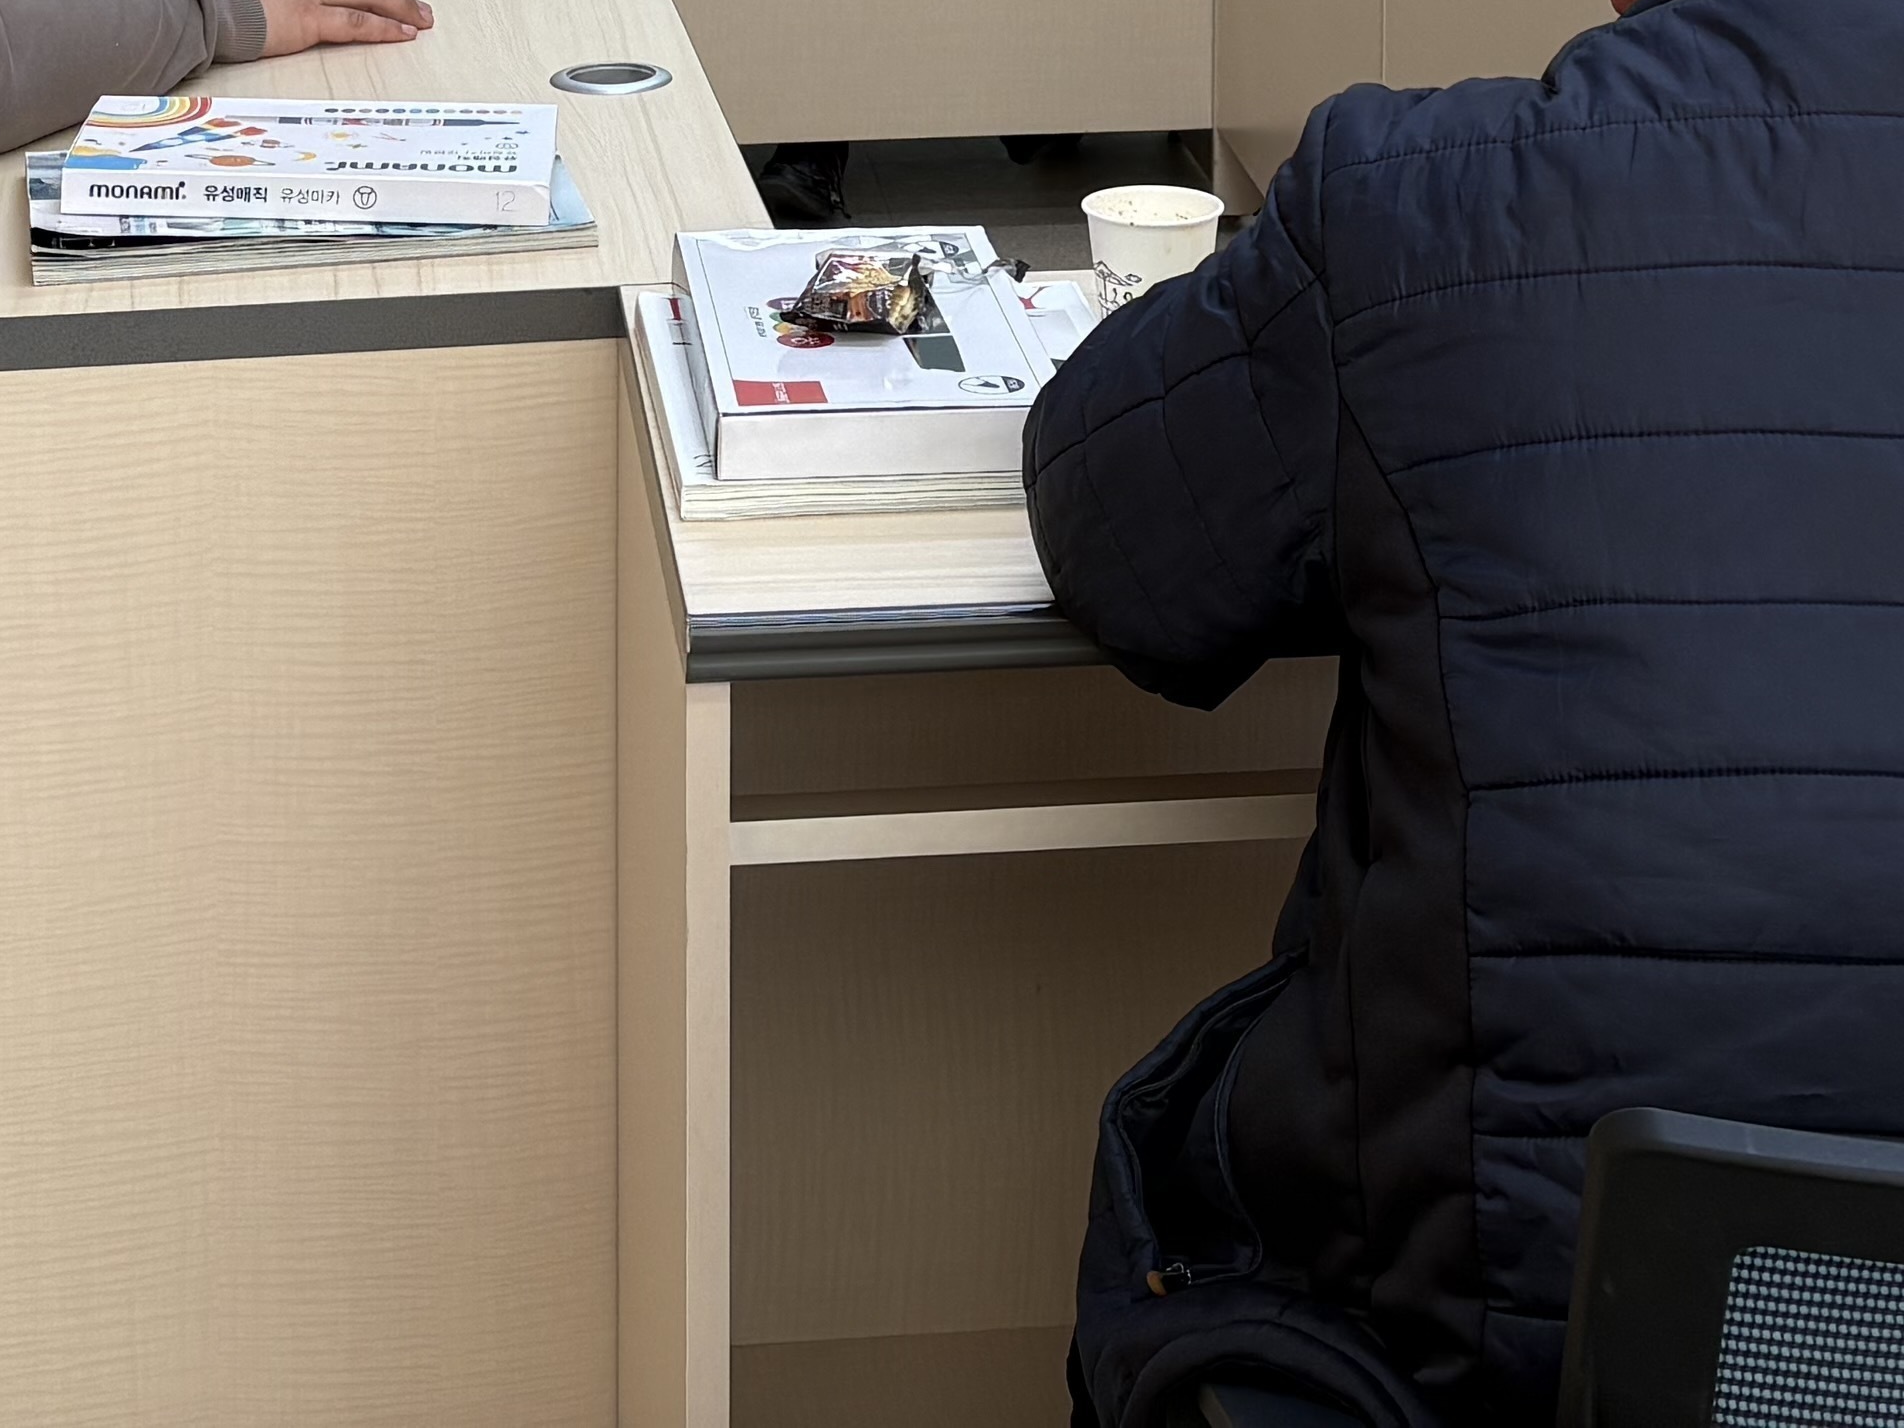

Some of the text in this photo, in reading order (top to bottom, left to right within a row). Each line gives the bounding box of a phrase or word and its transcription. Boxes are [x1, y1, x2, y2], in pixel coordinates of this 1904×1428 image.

[88, 180, 187, 201] monami
[203, 184, 269, 204] 유성매직
[494, 190, 517, 213] 12
